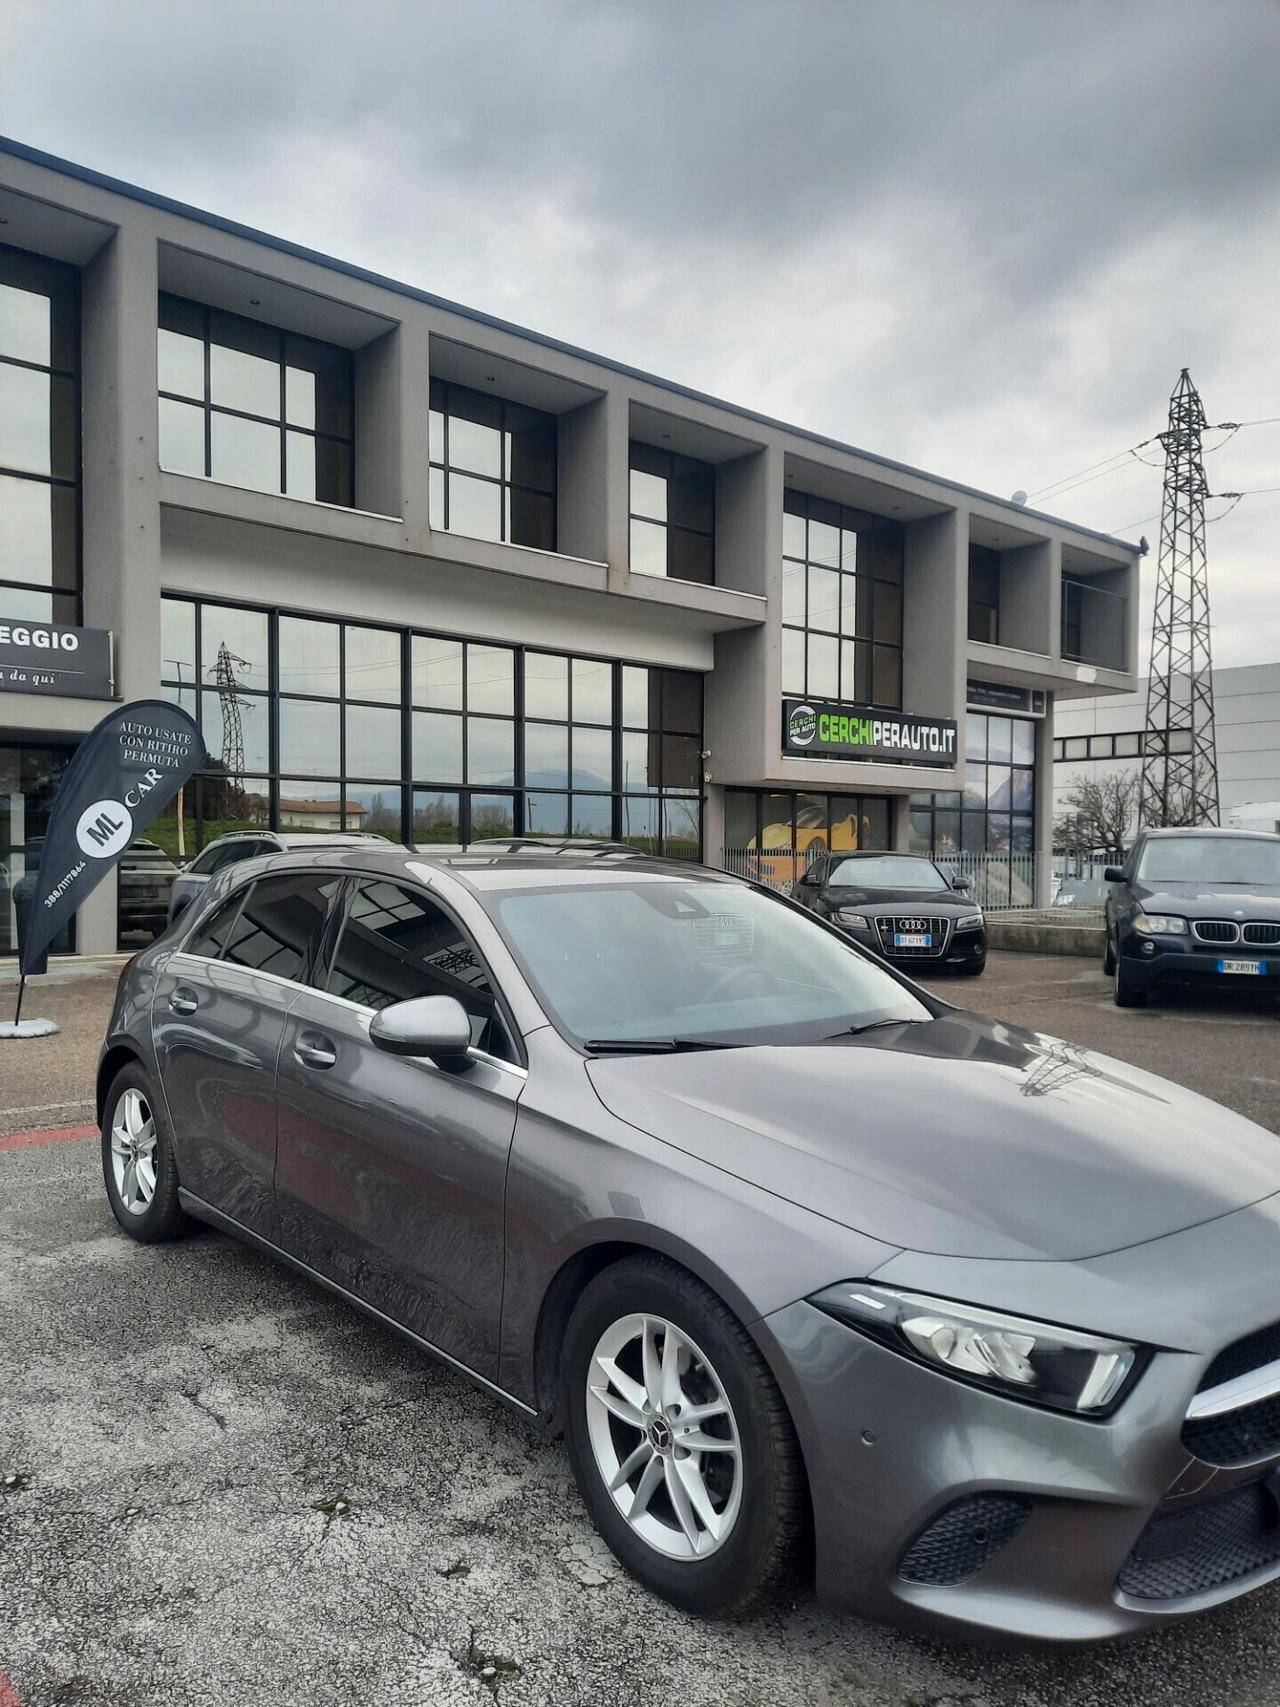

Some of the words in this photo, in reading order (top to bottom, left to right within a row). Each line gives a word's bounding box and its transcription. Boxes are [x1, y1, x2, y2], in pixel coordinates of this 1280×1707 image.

[10, 669, 26, 681] da
[32, 673, 55, 686] qui
[119, 721, 153, 736] AUTO
[155, 727, 192, 745] USATE
[802, 722, 816, 733] AUTO
[819, 713, 955, 753] CERCHIPERAUTO.IT
[119, 735, 144, 748] CON
[147, 740, 183, 756] RITIRO
[124, 749, 179, 768] PERMUTA
[86, 812, 124, 847] ML
[124, 768, 163, 808] CAR
[44, 860, 87, 908] 388/1117864
